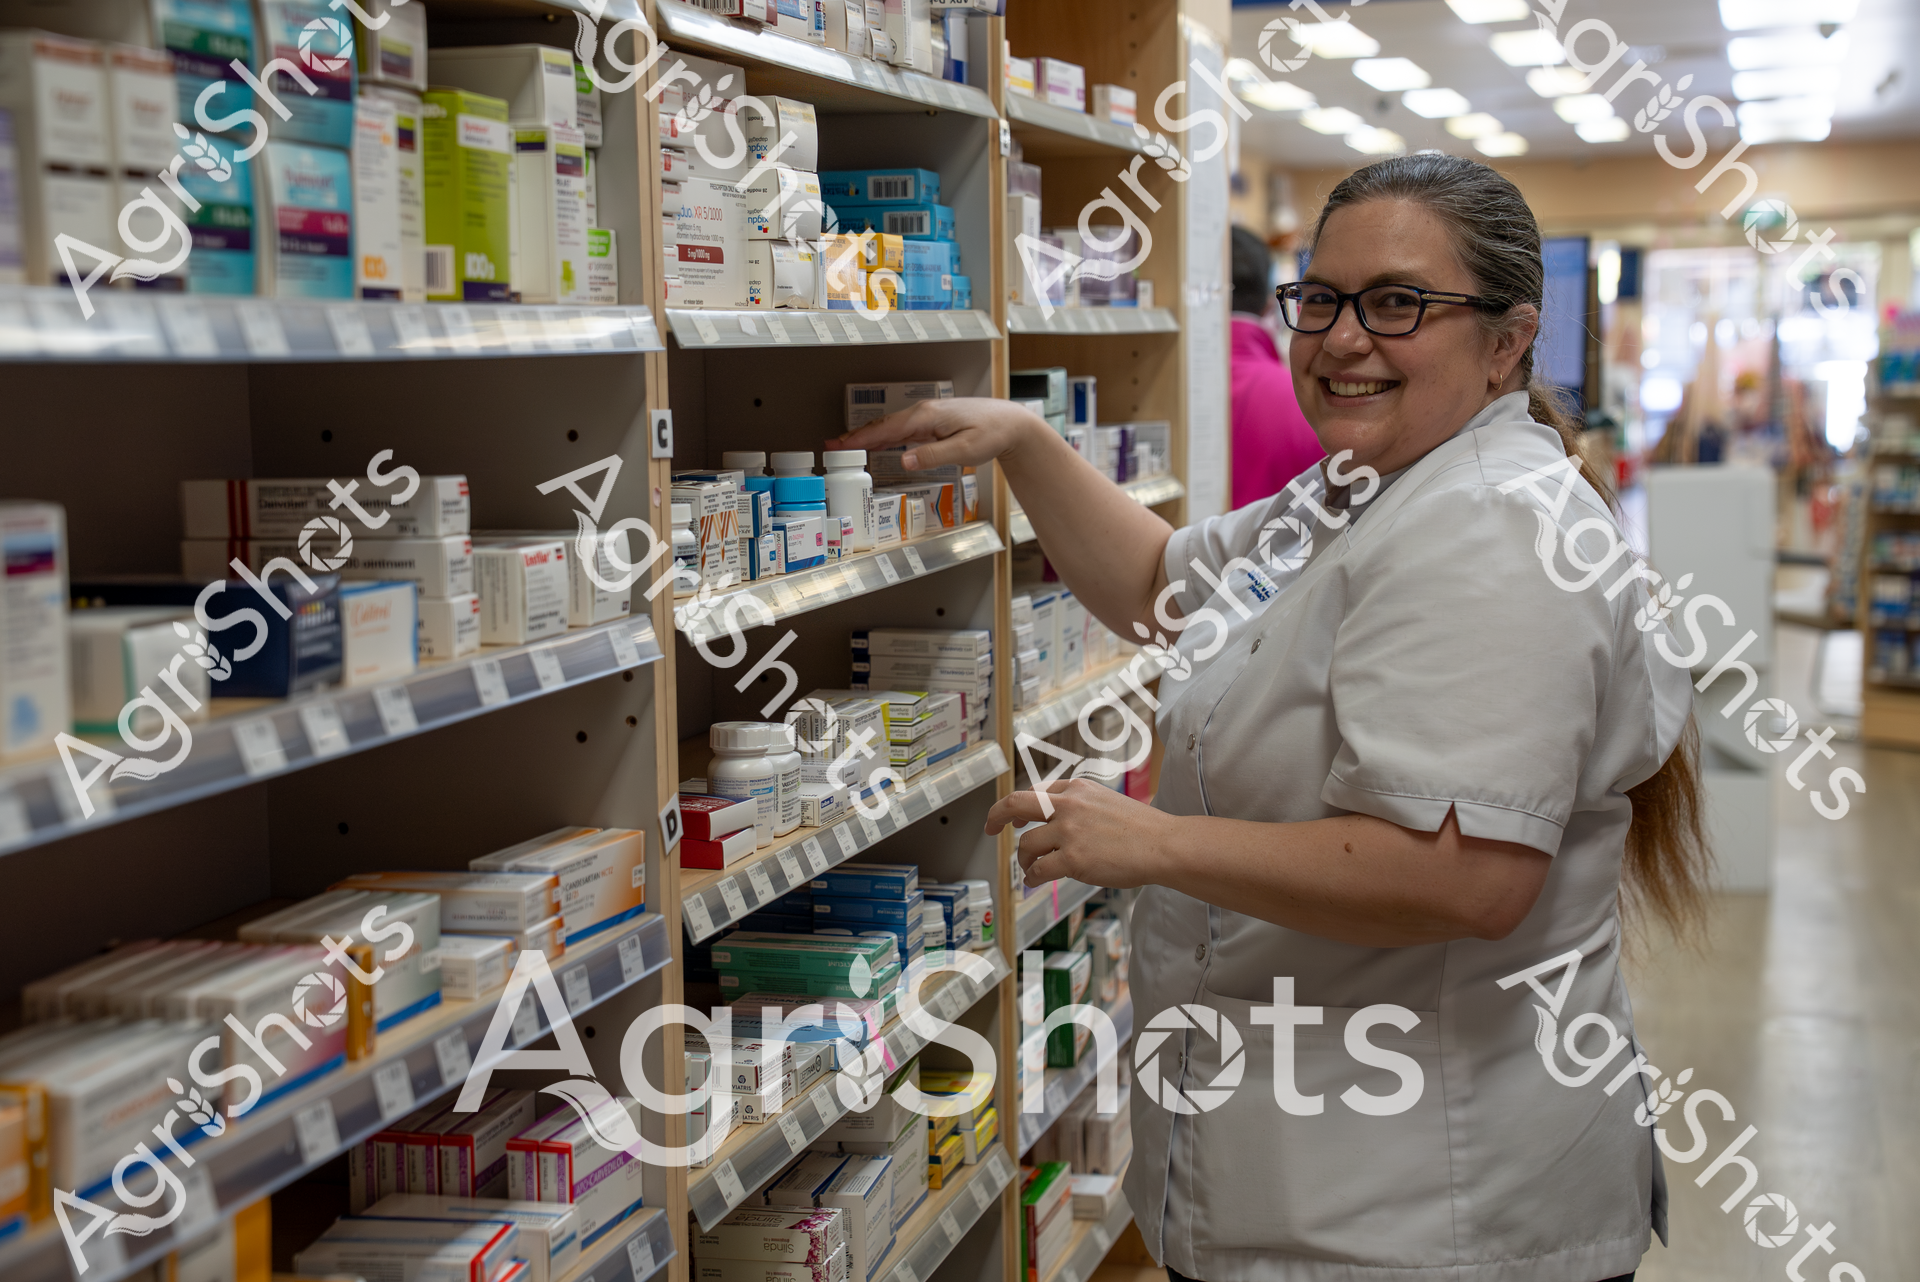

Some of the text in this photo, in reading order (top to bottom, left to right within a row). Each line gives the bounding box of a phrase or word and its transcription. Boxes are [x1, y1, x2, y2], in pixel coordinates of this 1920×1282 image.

[704, 206, 722, 221] 5/1000
[658, 418, 668, 449] C
[666, 808, 678, 842] D
[732, 1084, 752, 1092] VIATRIS
[764, 1242, 795, 1254] Slinda
